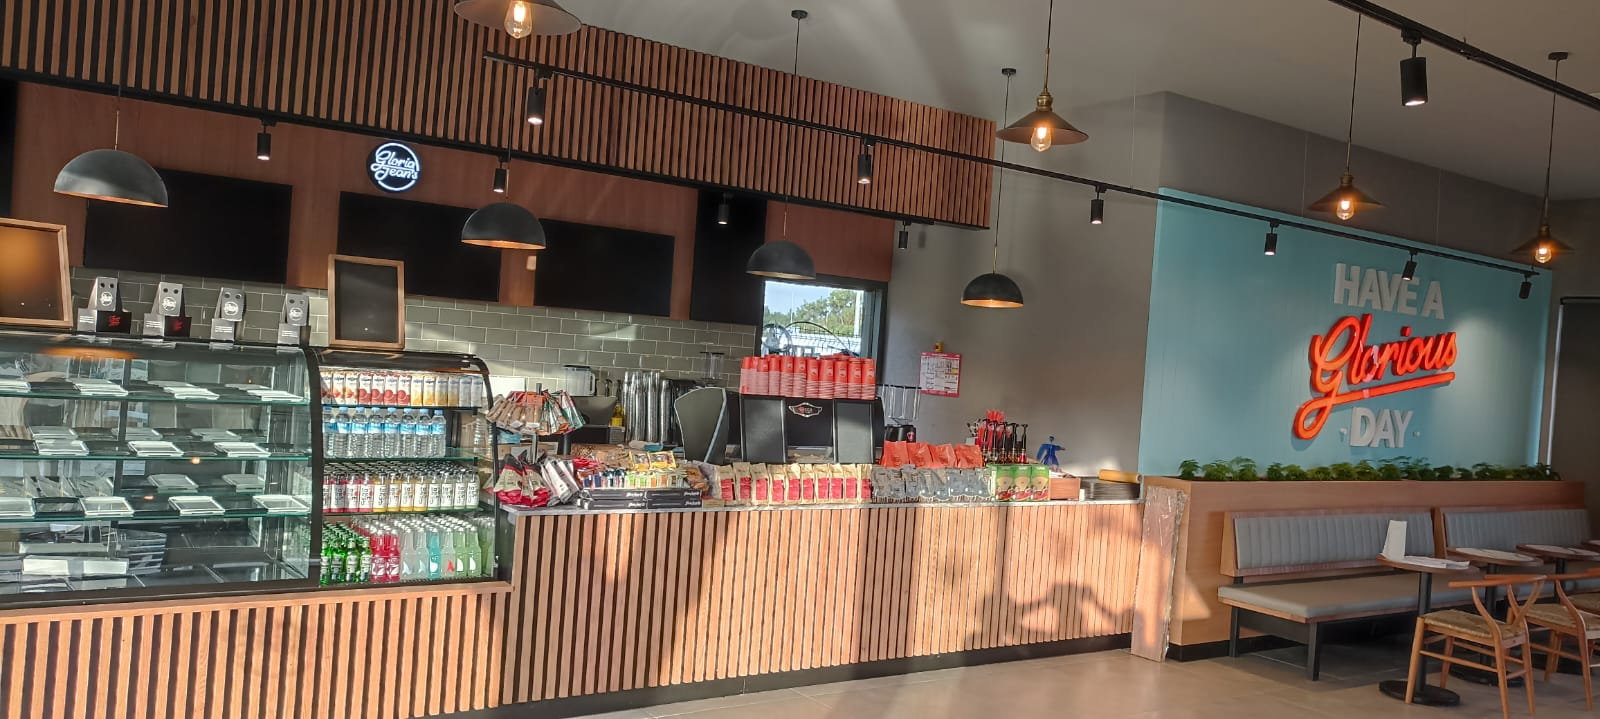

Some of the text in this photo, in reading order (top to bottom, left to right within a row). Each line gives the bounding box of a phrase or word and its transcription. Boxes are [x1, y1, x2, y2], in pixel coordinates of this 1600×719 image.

[370, 150, 415, 171] Gloria
[1333, 263, 1446, 320] HAVE A
[1293, 313, 1458, 440] Glorious
[1350, 406, 1414, 449] DAY
